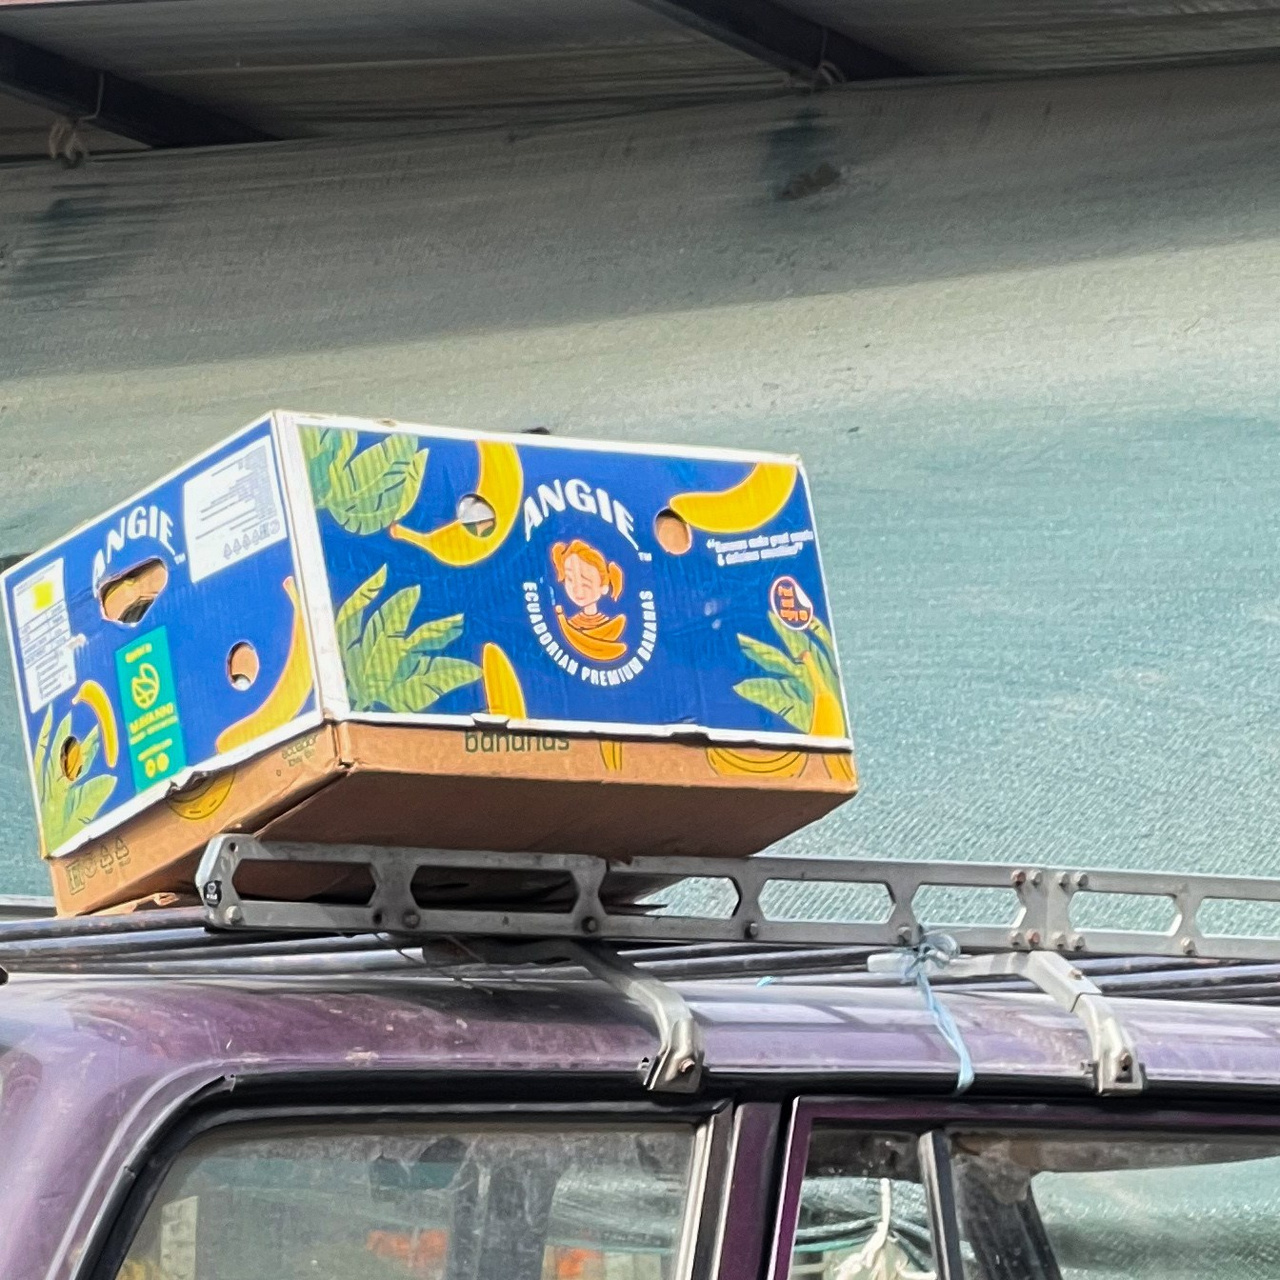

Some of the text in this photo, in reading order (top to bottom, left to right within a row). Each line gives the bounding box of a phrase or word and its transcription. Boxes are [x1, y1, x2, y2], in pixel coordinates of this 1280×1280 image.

[92, 505, 175, 598] ANGIE
[523, 478, 639, 550] ANGIE
[522, 582, 657, 686] ECUADORIAN PREMIUM BANANAS
